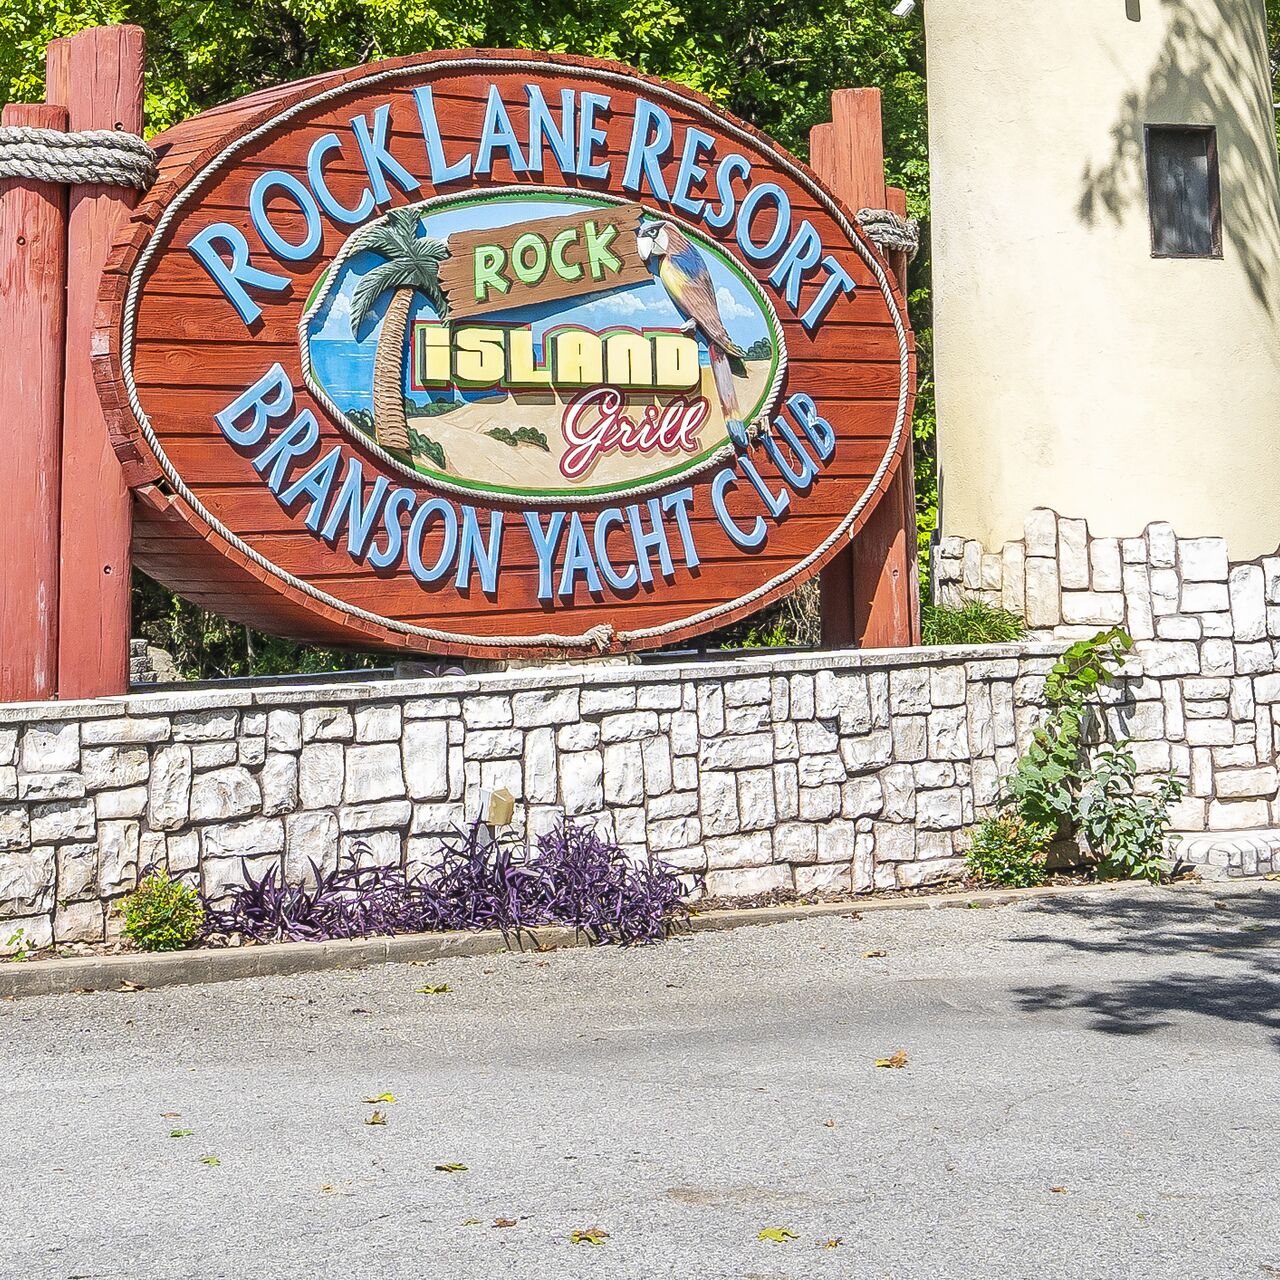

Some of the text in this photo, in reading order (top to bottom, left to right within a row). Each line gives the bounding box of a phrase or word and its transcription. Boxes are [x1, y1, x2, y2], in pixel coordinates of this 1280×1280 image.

[188, 83, 856, 329] ROCK LANE RESORT
[472, 220, 622, 302] ROCK
[214, 362, 837, 599] BRANSON YACHT CLUB
[560, 388, 708, 479] Grill
